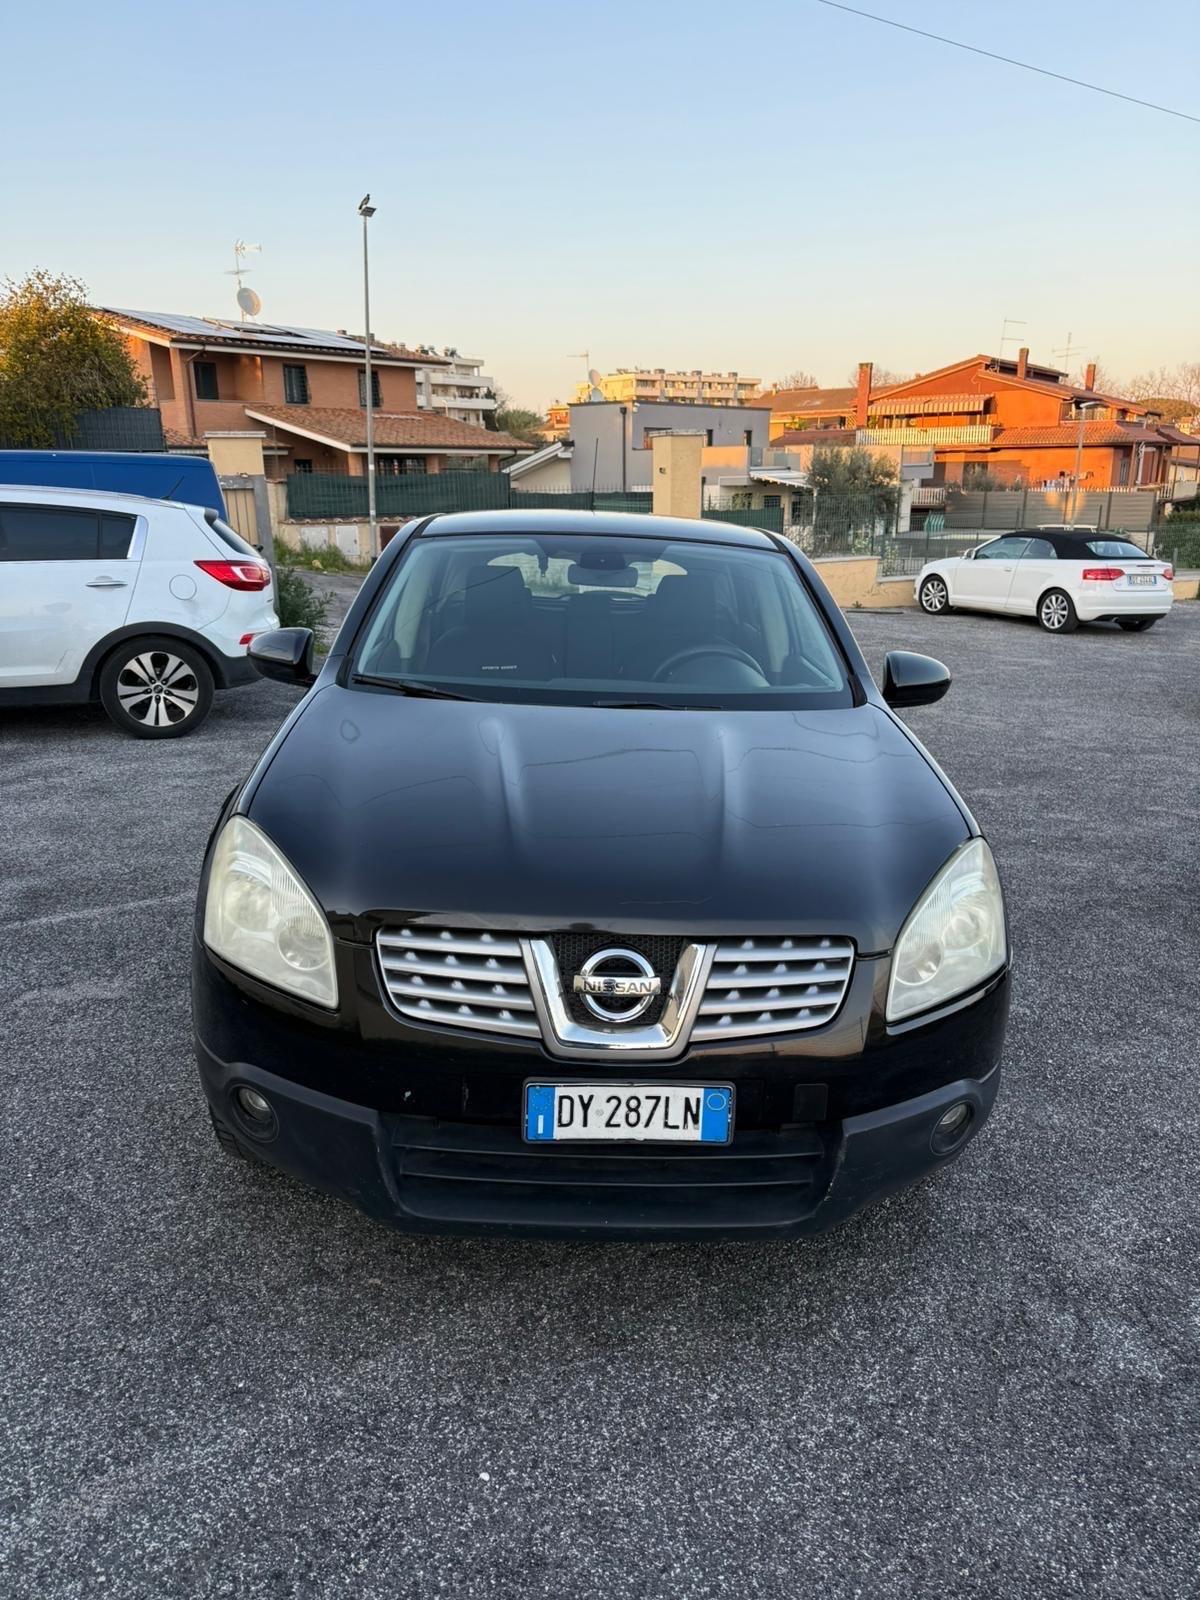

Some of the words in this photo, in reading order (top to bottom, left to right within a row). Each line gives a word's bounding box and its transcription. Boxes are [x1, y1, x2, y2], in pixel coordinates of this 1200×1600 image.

[583, 979, 652, 993] NISSAN
[557, 1094, 594, 1128] DY
[604, 1095, 701, 1131] 287LN
